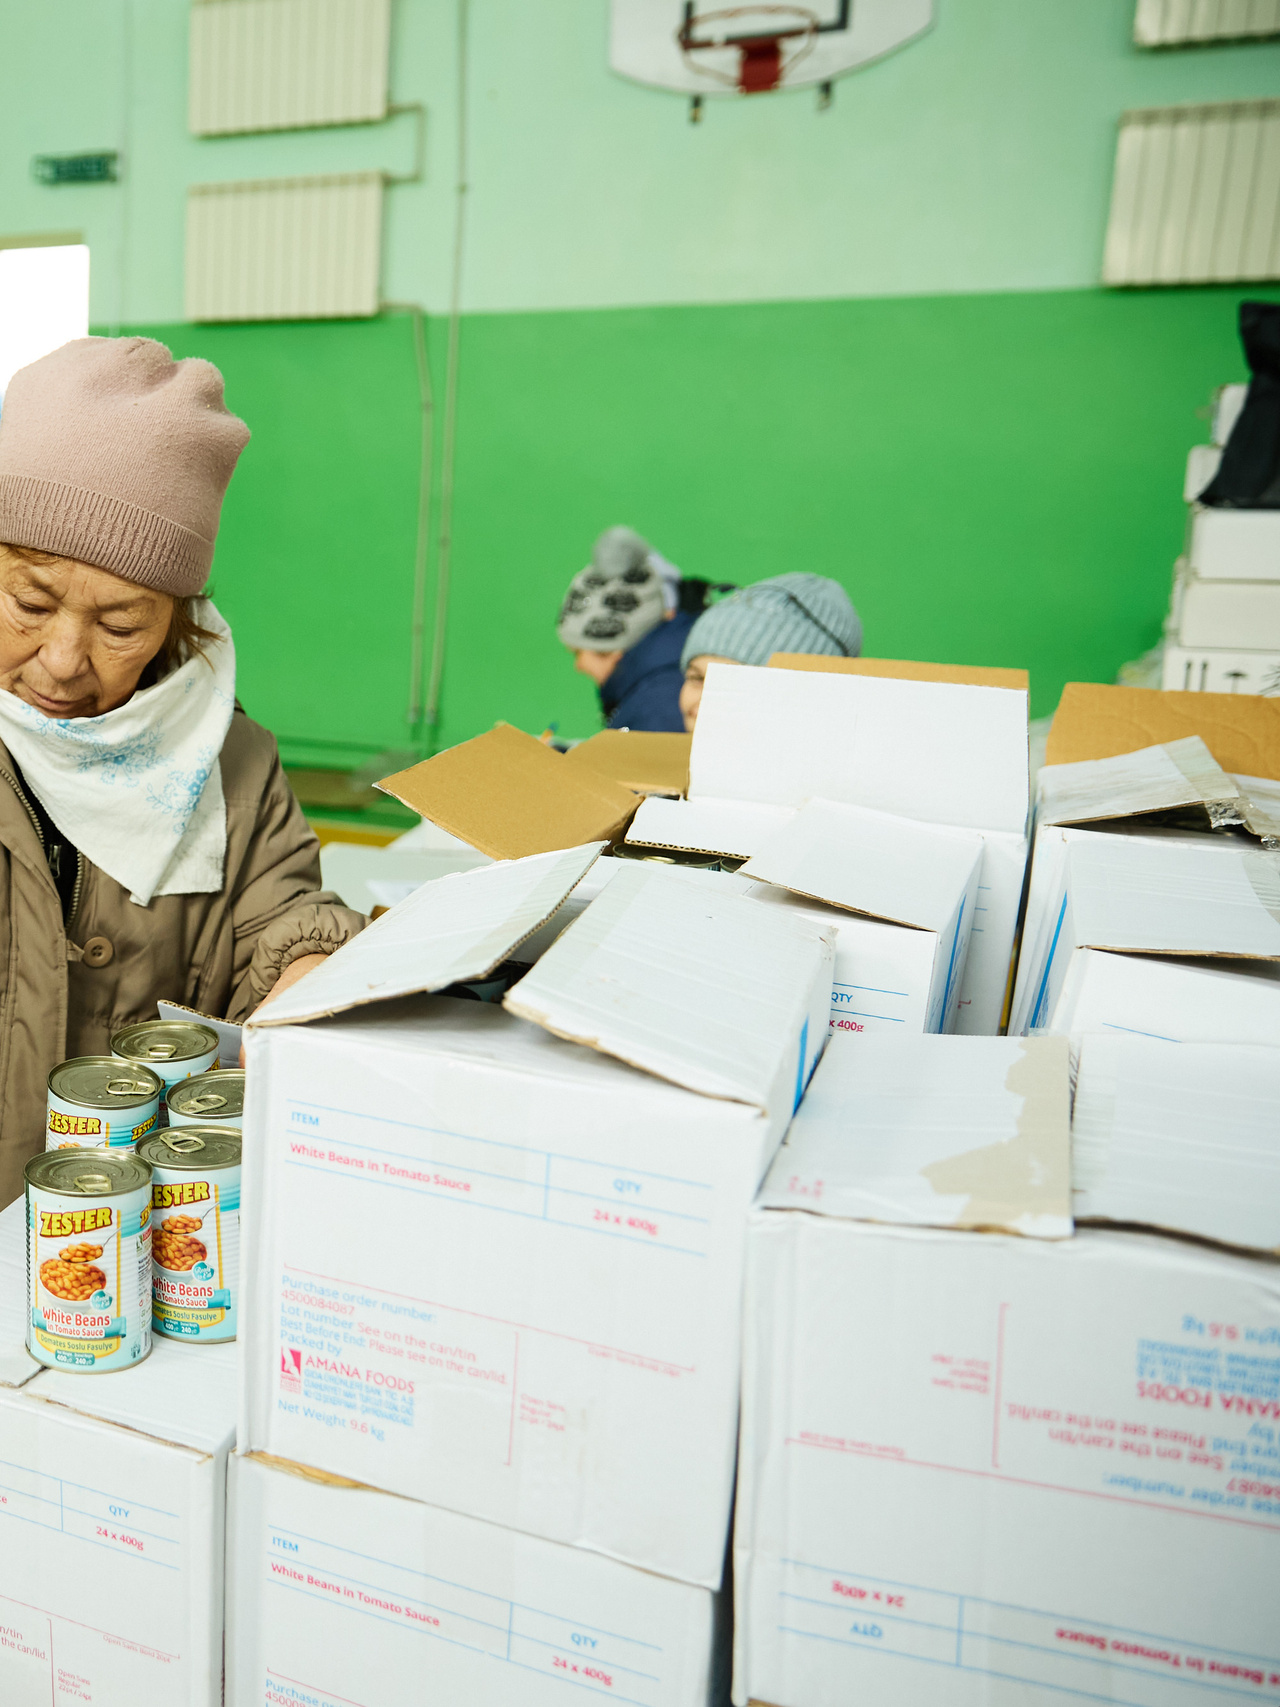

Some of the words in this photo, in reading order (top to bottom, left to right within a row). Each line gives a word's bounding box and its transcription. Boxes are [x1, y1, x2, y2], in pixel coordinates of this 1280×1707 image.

[831, 992, 853, 1002] QTY
[837, 1020, 864, 1032] 400g
[49, 1110, 101, 1135] ZESTER
[292, 1111, 319, 1126] ITEM
[290, 1142, 325, 1160] White
[328, 1151, 364, 1168] Beans
[368, 1160, 379, 1172] in
[382, 1162, 430, 1183] Tomato
[434, 1174, 471, 1192] Sauce
[152, 1182, 210, 1210] ESTER
[613, 1178, 642, 1194] QTY
[40, 1206, 112, 1238] ZESTER
[593, 1208, 610, 1224] 24
[626, 1216, 659, 1236] 400g
[162, 1294, 184, 1306] Tomato
[186, 1297, 206, 1306] Sauce
[178, 1284, 213, 1296] Beans
[282, 1274, 339, 1299] Purchase
[342, 1292, 377, 1308] order
[282, 1289, 355, 1316] 4500084087
[42, 1307, 72, 1326] White
[75, 1314, 110, 1327] Beans
[174, 1310, 190, 1320] Soslu
[192, 1312, 216, 1322] Fasulye
[48, 1323, 54, 1332] in
[55, 1326, 80, 1336] Tomato
[82, 1328, 103, 1336] Sauce
[281, 1302, 300, 1316] Lot
[304, 1308, 354, 1330] number
[357, 1322, 380, 1336] See
[384, 1329, 401, 1342] on
[404, 1334, 426, 1349] the
[430, 1341, 477, 1362] can/tin
[40, 1334, 66, 1348] Domates
[67, 1340, 86, 1350] Soslu
[87, 1340, 112, 1350] Fasulye
[280, 1329, 324, 1350] Packed
[327, 1339, 342, 1357] by
[280, 1316, 303, 1330] Best
[305, 1320, 340, 1341] Before
[369, 1338, 404, 1357] Please
[407, 1349, 426, 1363] see
[429, 1353, 443, 1368] on
[446, 1357, 464, 1372] the
[306, 1355, 361, 1380] AMANA
[366, 1370, 414, 1394] FOODS
[1136, 1380, 1212, 1410] FOODS
[278, 1399, 299, 1414] Net
[302, 1406, 346, 1428] Weight
[350, 1419, 368, 1434] 9.6
[371, 1426, 385, 1442] kg
[1066, 1410, 1092, 1430] the
[1096, 1416, 1116, 1432] on
[1121, 1421, 1148, 1437] see
[1152, 1424, 1206, 1451] Please
[1120, 1440, 1152, 1458] the
[1156, 1445, 1182, 1462] on
[1186, 1449, 1224, 1472] See
[109, 1504, 130, 1518] QTY
[96, 1526, 108, 1537] 24
[120, 1534, 144, 1551] 400g
[272, 1536, 298, 1552] ITEM
[272, 1562, 304, 1582] White
[307, 1574, 340, 1594] Beans
[344, 1586, 354, 1598] in
[357, 1590, 402, 1614] Tomato
[405, 1607, 440, 1626] Sauce
[833, 1580, 867, 1598] 400g
[887, 1595, 905, 1608] 24
[571, 1632, 598, 1648] QTY
[852, 1622, 882, 1637] QTY
[1055, 1628, 1108, 1650] Sauce
[1, 1636, 16, 1648] the
[17, 1642, 48, 1661] can/lid.
[1111, 1640, 1181, 1667] Tomato
[552, 1656, 567, 1668] 24
[582, 1666, 613, 1687] 400g
[1185, 1655, 1205, 1672] in
[1208, 1660, 1264, 1685] Beans
[266, 1678, 318, 1706] Purchase
